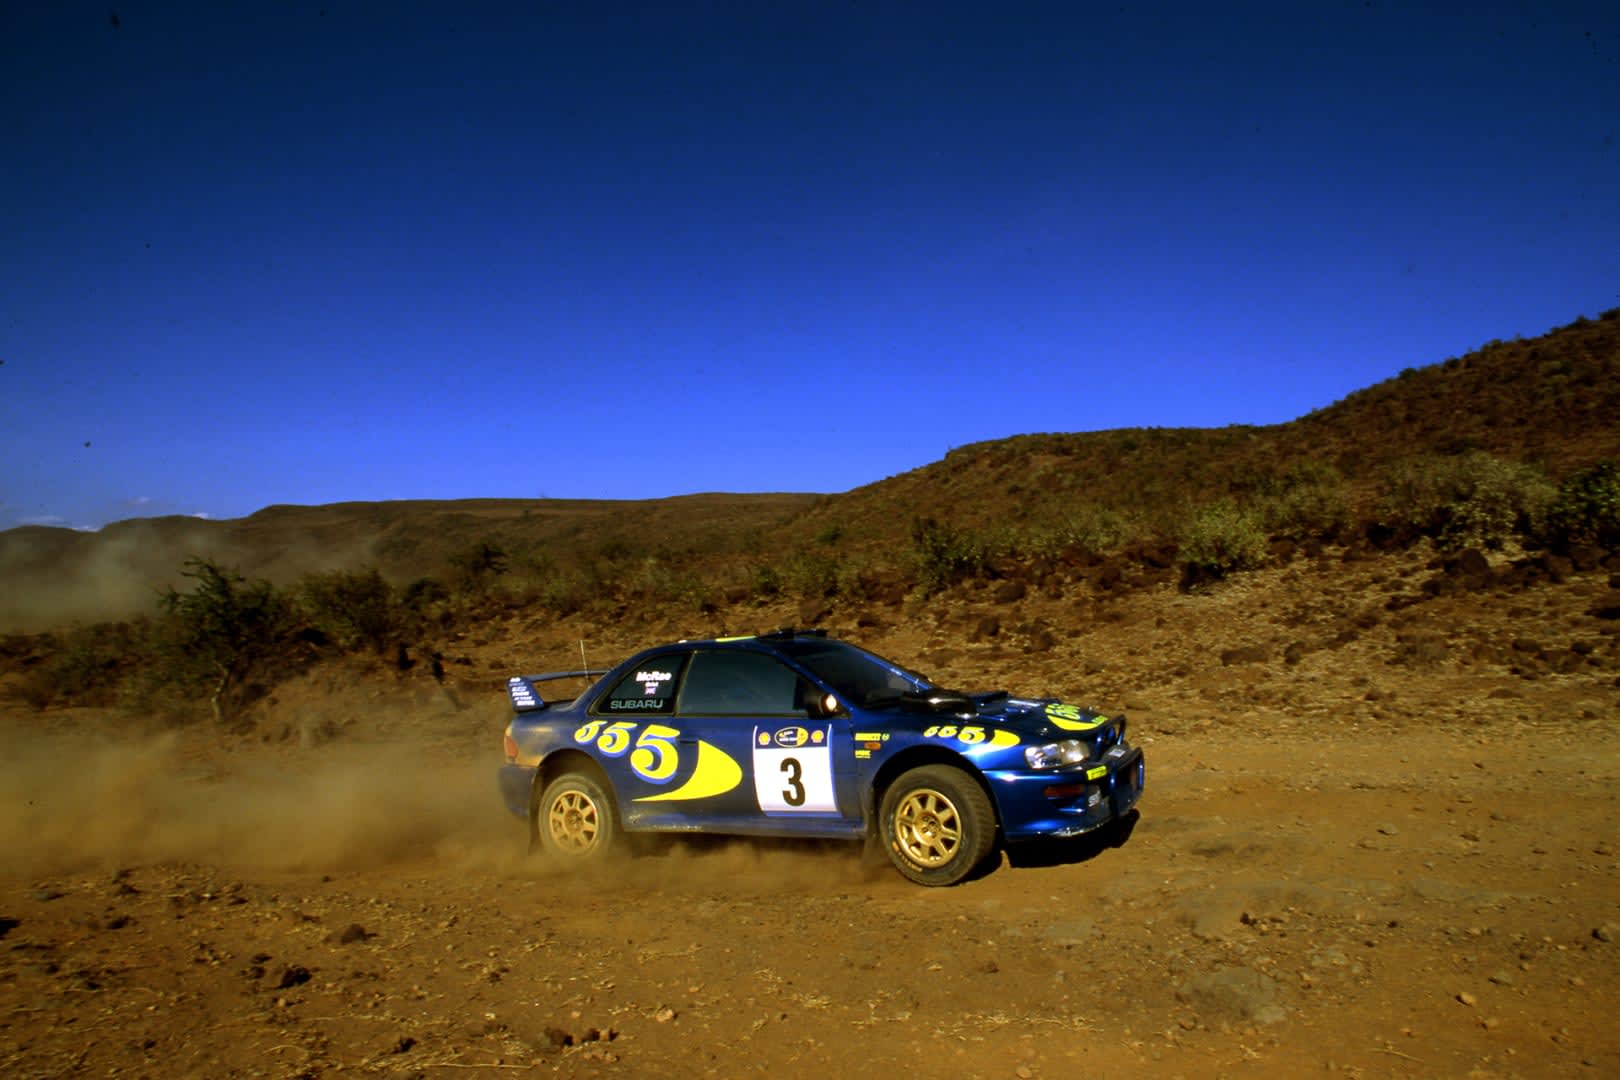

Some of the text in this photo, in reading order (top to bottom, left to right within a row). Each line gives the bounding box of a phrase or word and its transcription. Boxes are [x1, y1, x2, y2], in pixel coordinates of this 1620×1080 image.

[610, 700, 663, 709] SUBARU
[923, 726, 985, 744] 555
[574, 720, 680, 784] 555
[780, 757, 806, 806] 3
